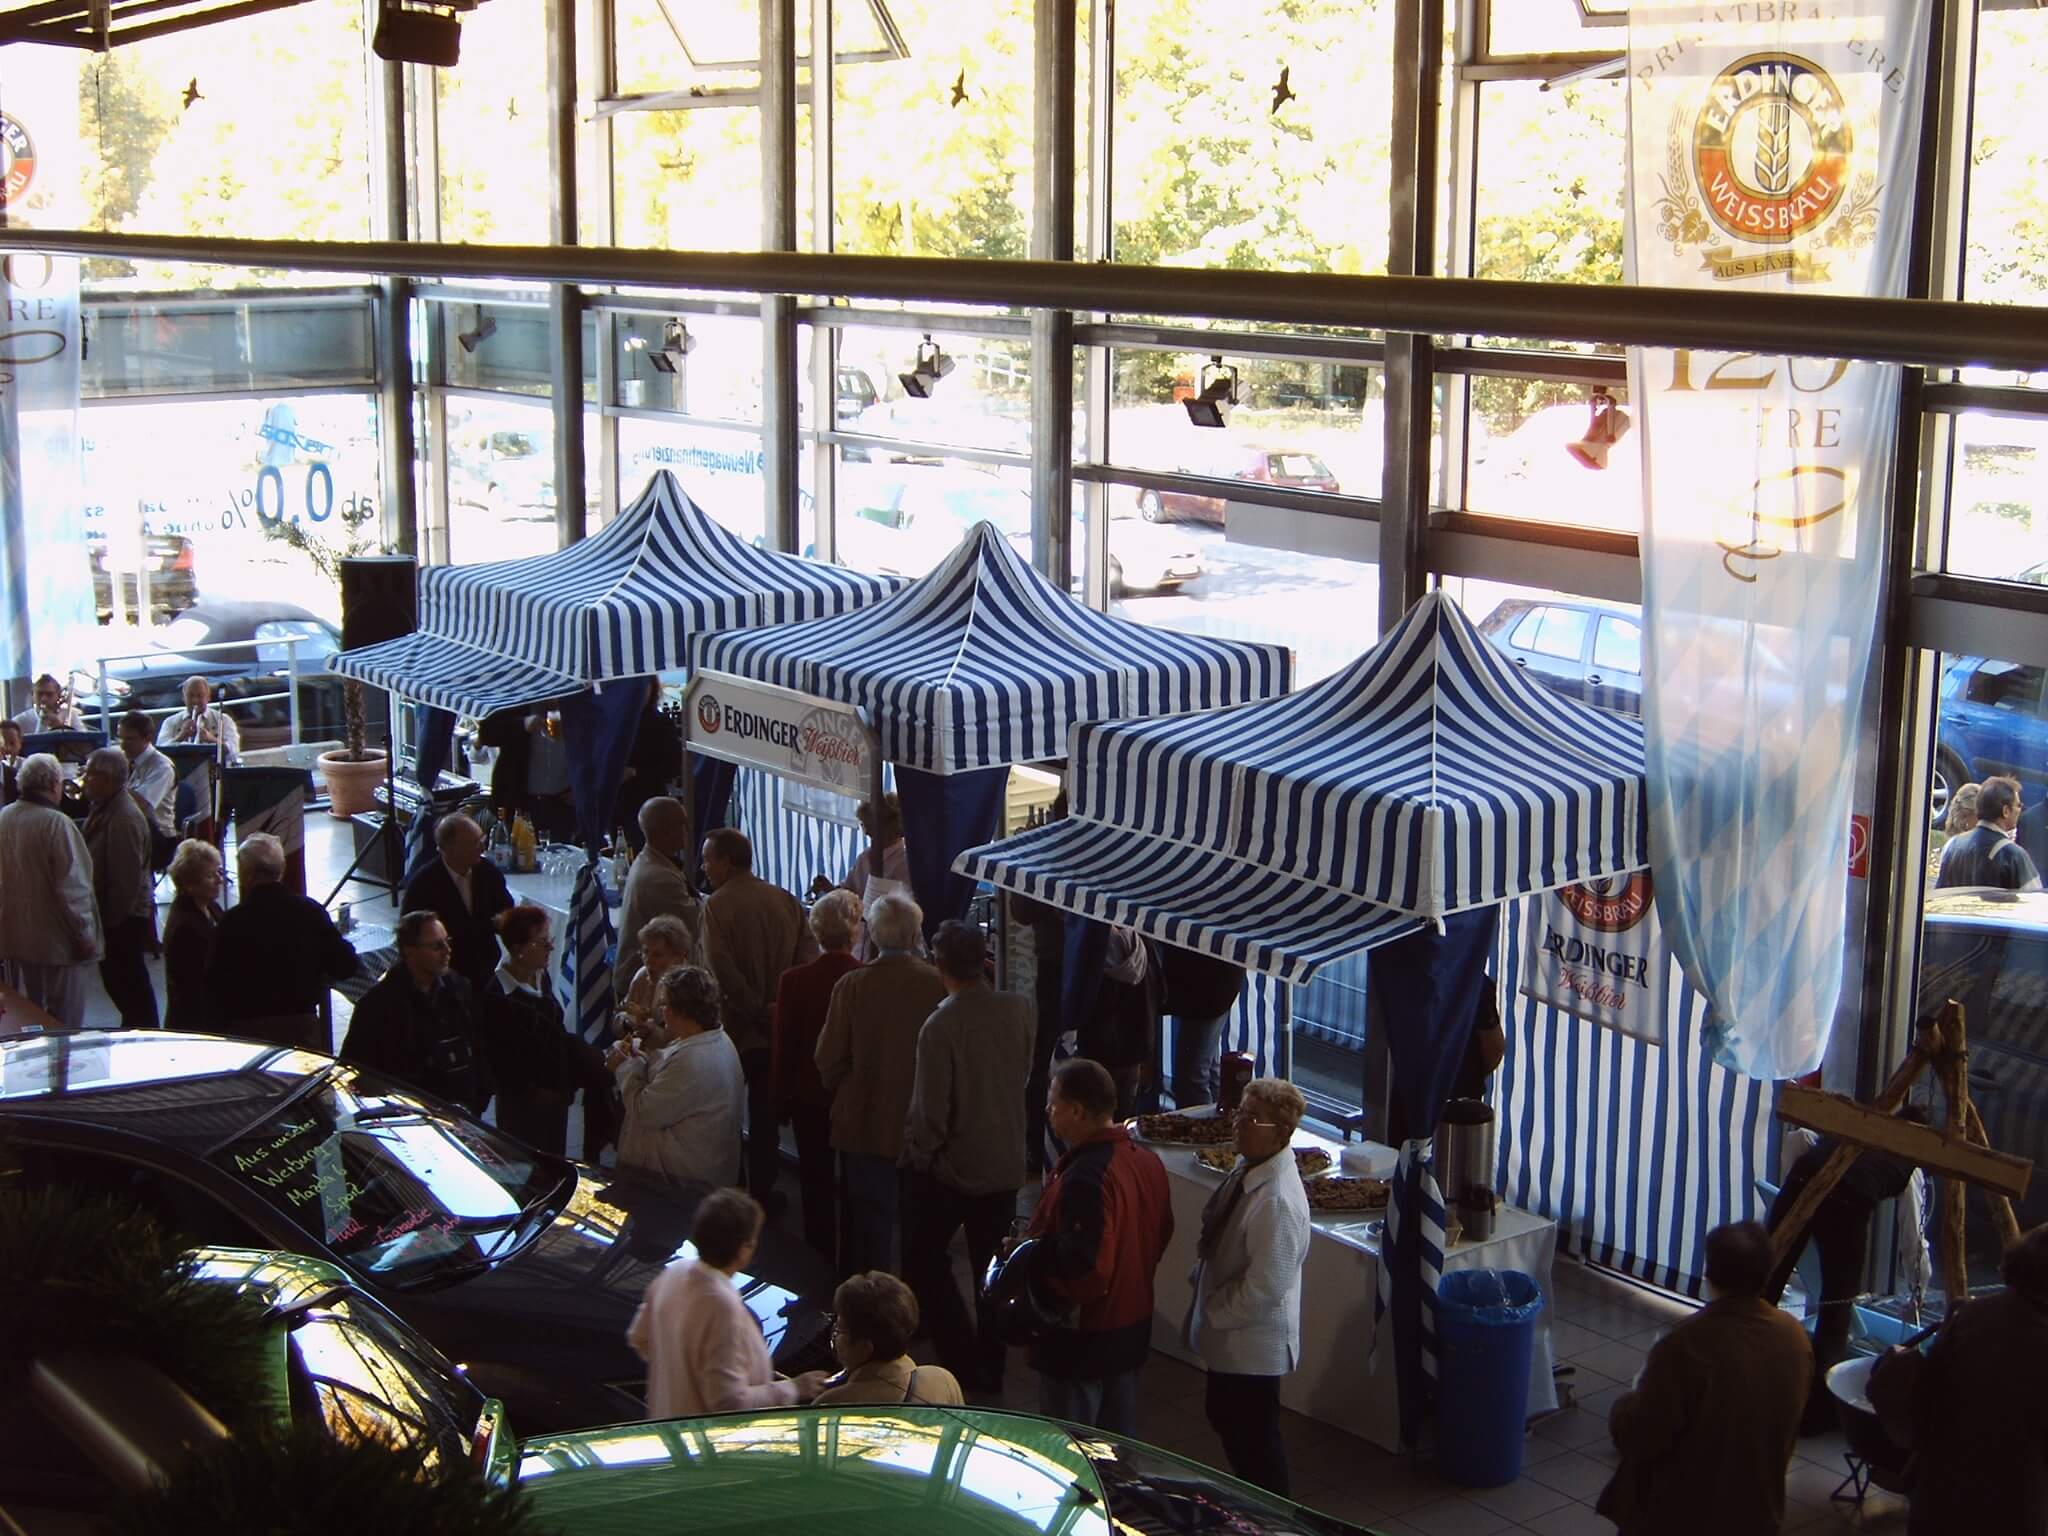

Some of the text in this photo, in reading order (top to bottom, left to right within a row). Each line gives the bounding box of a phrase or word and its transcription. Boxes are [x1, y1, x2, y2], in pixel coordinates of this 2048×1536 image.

[1710, 171, 1834, 230] WEISSBRÄU
[1716, 263, 1745, 278] AUS
[724, 704, 801, 754] ERDINGER
[1543, 923, 1648, 989] ERDINGER
[234, 1147, 269, 1172] Aus
[252, 1146, 331, 1188] Werbung
[286, 1173, 336, 1207] Mazda
